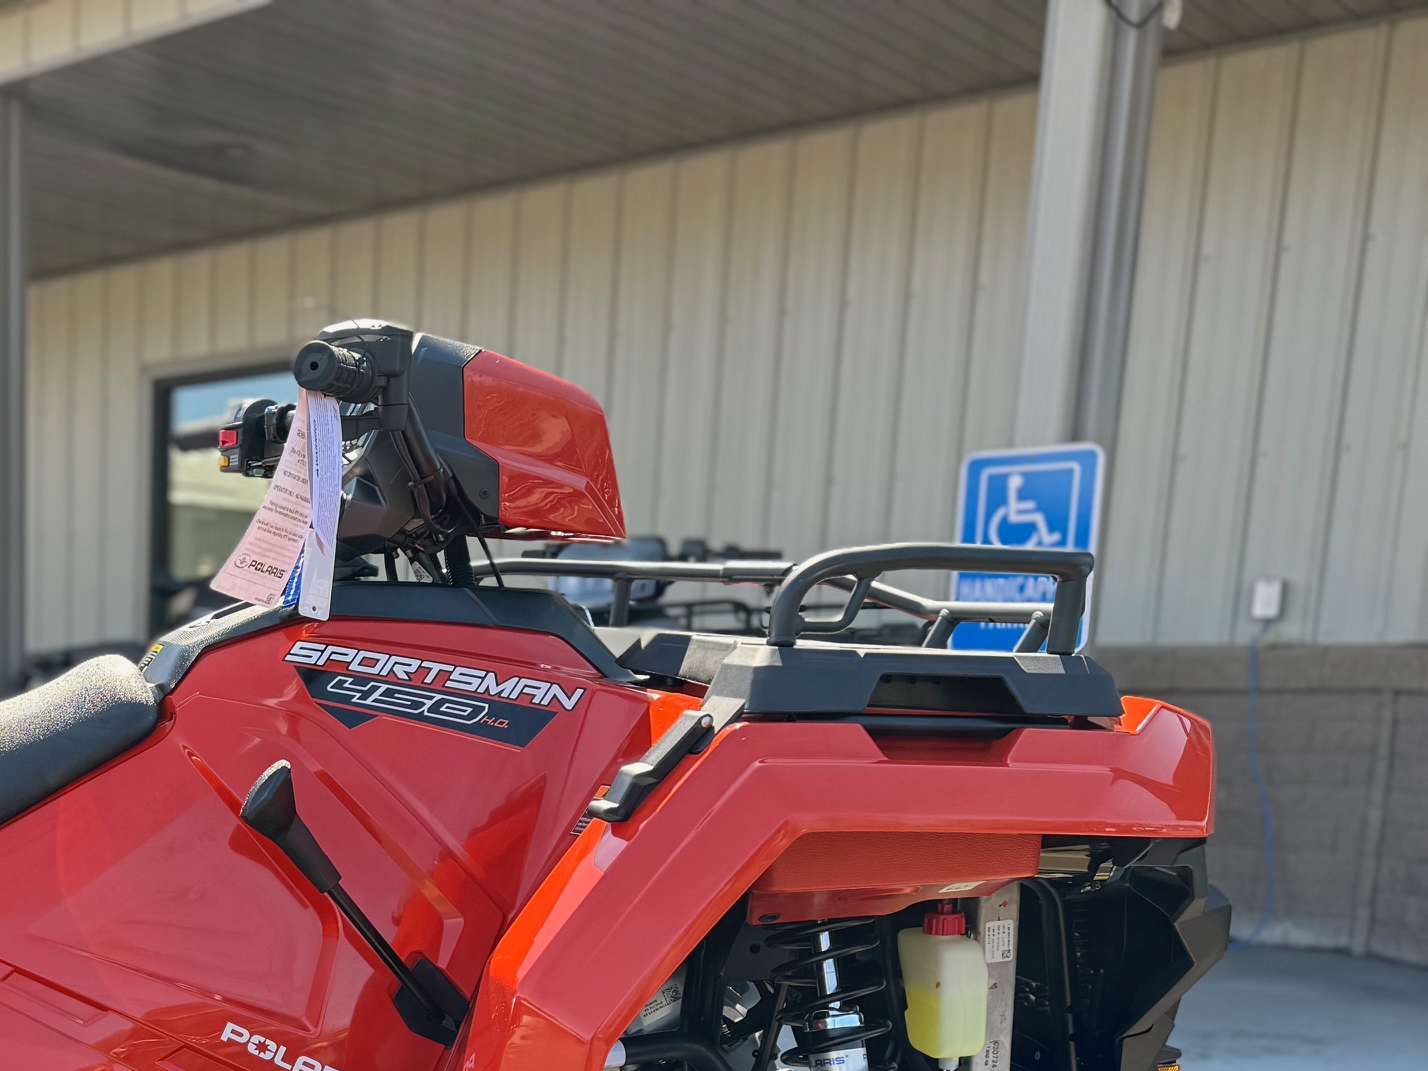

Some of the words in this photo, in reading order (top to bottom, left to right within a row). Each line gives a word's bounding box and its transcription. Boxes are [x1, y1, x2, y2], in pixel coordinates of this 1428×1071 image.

[248, 559, 286, 579] POLARIS
[284, 640, 585, 710] SPORTSMAN
[327, 676, 488, 724] 450
[480, 716, 509, 729] H.O.
[812, 1056, 846, 1068] ARIS
